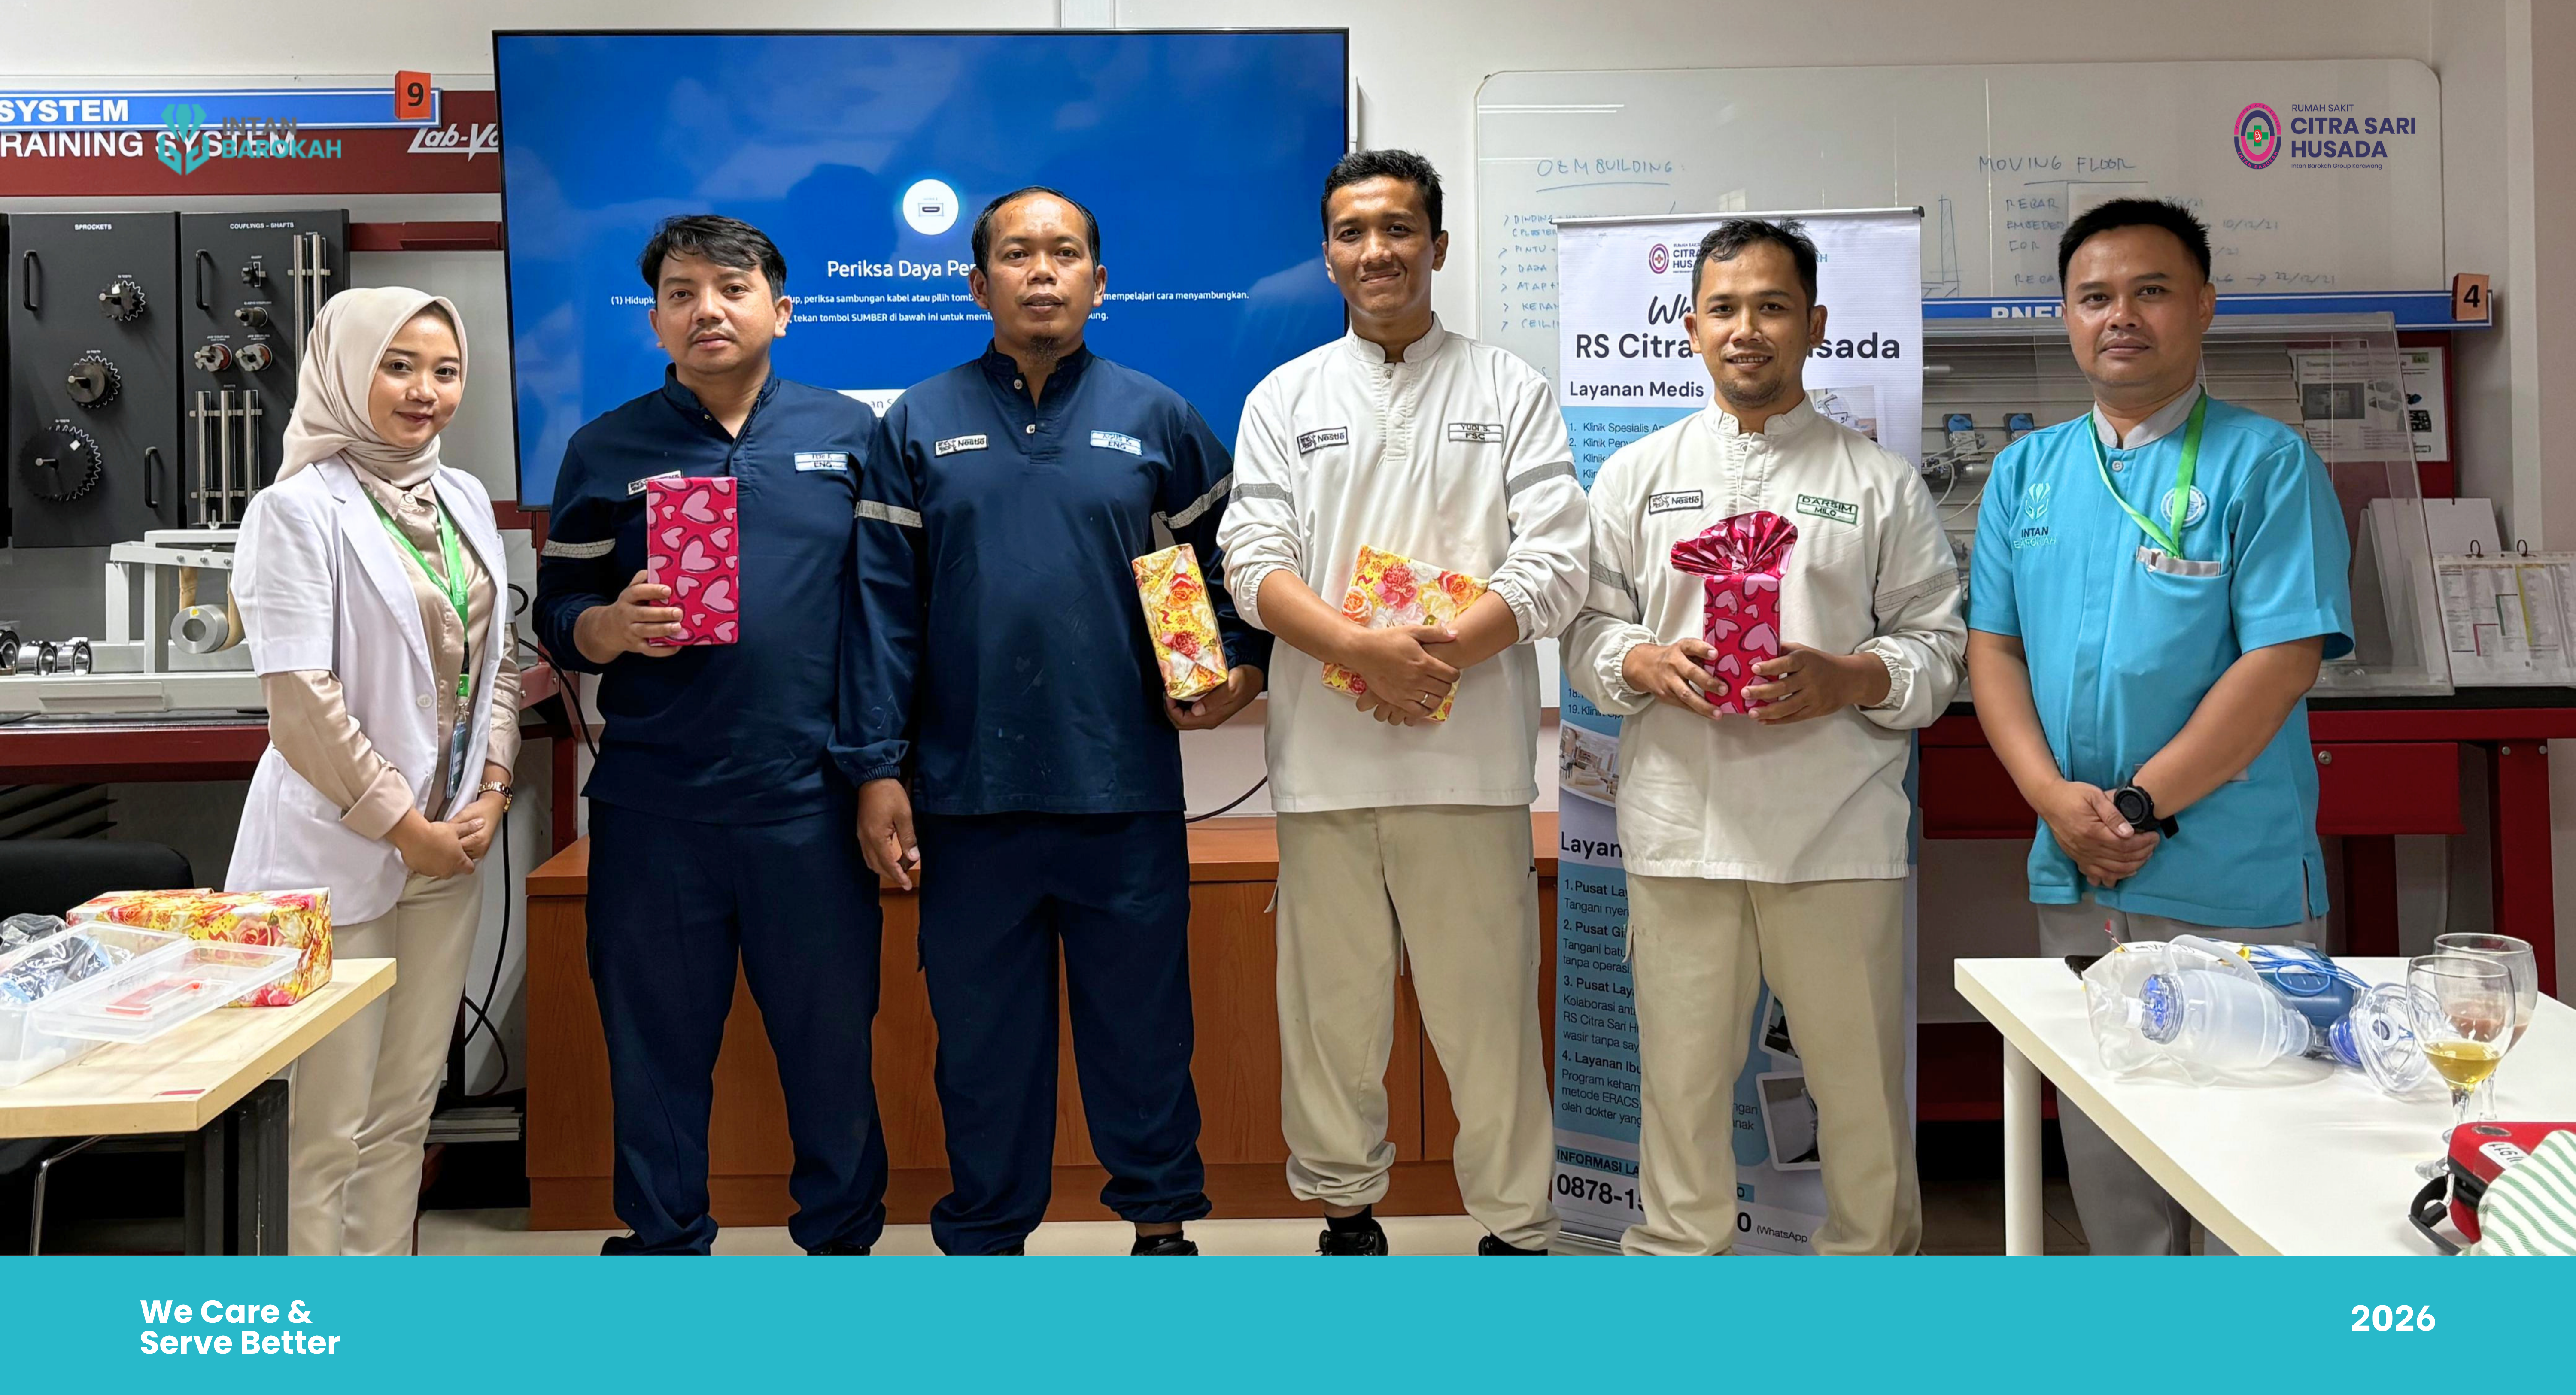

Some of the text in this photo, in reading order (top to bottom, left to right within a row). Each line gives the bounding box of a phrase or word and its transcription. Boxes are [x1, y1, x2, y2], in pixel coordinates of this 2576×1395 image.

[407, 82, 424, 106] 9
[0, 100, 128, 122] SYSTEM
[1979, 155, 2061, 172] MOVING
[828, 260, 893, 278] Periksa
[899, 260, 942, 281] Daya
[611, 296, 623, 306] (1)
[804, 295, 835, 305] periksa
[836, 294, 885, 305] sambungan
[887, 294, 910, 303] kabel
[931, 294, 949, 303] pilih
[1103, 291, 1154, 302] mempelajari
[1175, 291, 1249, 301] menyambungkan.
[2464, 284, 2480, 309] 4
[793, 314, 818, 322] tekan
[820, 313, 850, 322] tombol
[851, 314, 888, 322] SUMBER
[889, 313, 898, 322] di
[899, 313, 926, 322] bawah
[928, 313, 939, 321] ini
[940, 313, 965, 321] untuk
[1576, 334, 1610, 358] RS
[1619, 333, 1694, 358] Citra
[1570, 381, 1704, 400] Layanan Medis
[1570, 422, 1577, 431] 1.
[1583, 422, 1606, 431] Klinik
[1608, 422, 1649, 434] Spesialis
[1569, 437, 1577, 447] 2.
[1583, 438, 1606, 448] Klinik
[1583, 454, 1606, 463] Klinik
[1814, 507, 1837, 517] MILO
[2021, 526, 2049, 538] INTAN
[1568, 704, 1580, 714] 19.
[1561, 831, 1623, 860] Layan
[1565, 879, 1573, 891] 1.
[1575, 880, 1608, 895] Pusat
[1564, 897, 1602, 914] Tangani
[1563, 919, 1572, 931] 2.
[1575, 921, 1608, 936] Pusat
[1563, 938, 1626, 958] Tangani batu
[1563, 955, 1632, 974] tanpa operasi.
[1564, 975, 1573, 987] 3.
[1576, 977, 1610, 992] Pusat
[1563, 994, 1616, 1012] Kolaborasi
[1563, 1011, 1577, 1024] RS
[1580, 1014, 1604, 1028] Citra
[1607, 1018, 1626, 1032] Sari
[1563, 1031, 1639, 1053] wasir tanpa say
[1562, 1049, 1571, 1062] 4.
[1575, 1052, 1622, 1071] Layanan
[1561, 1068, 1641, 1093] Program keham
[1561, 1086, 1600, 1101] metode
[1561, 1101, 1582, 1114] oleh
[1585, 1105, 1616, 1120] dokter
[1557, 1149, 1622, 1173] INFORMASI
[1737, 1211, 1752, 1233] 0
[1756, 1225, 1808, 1243] (WhatsApp
